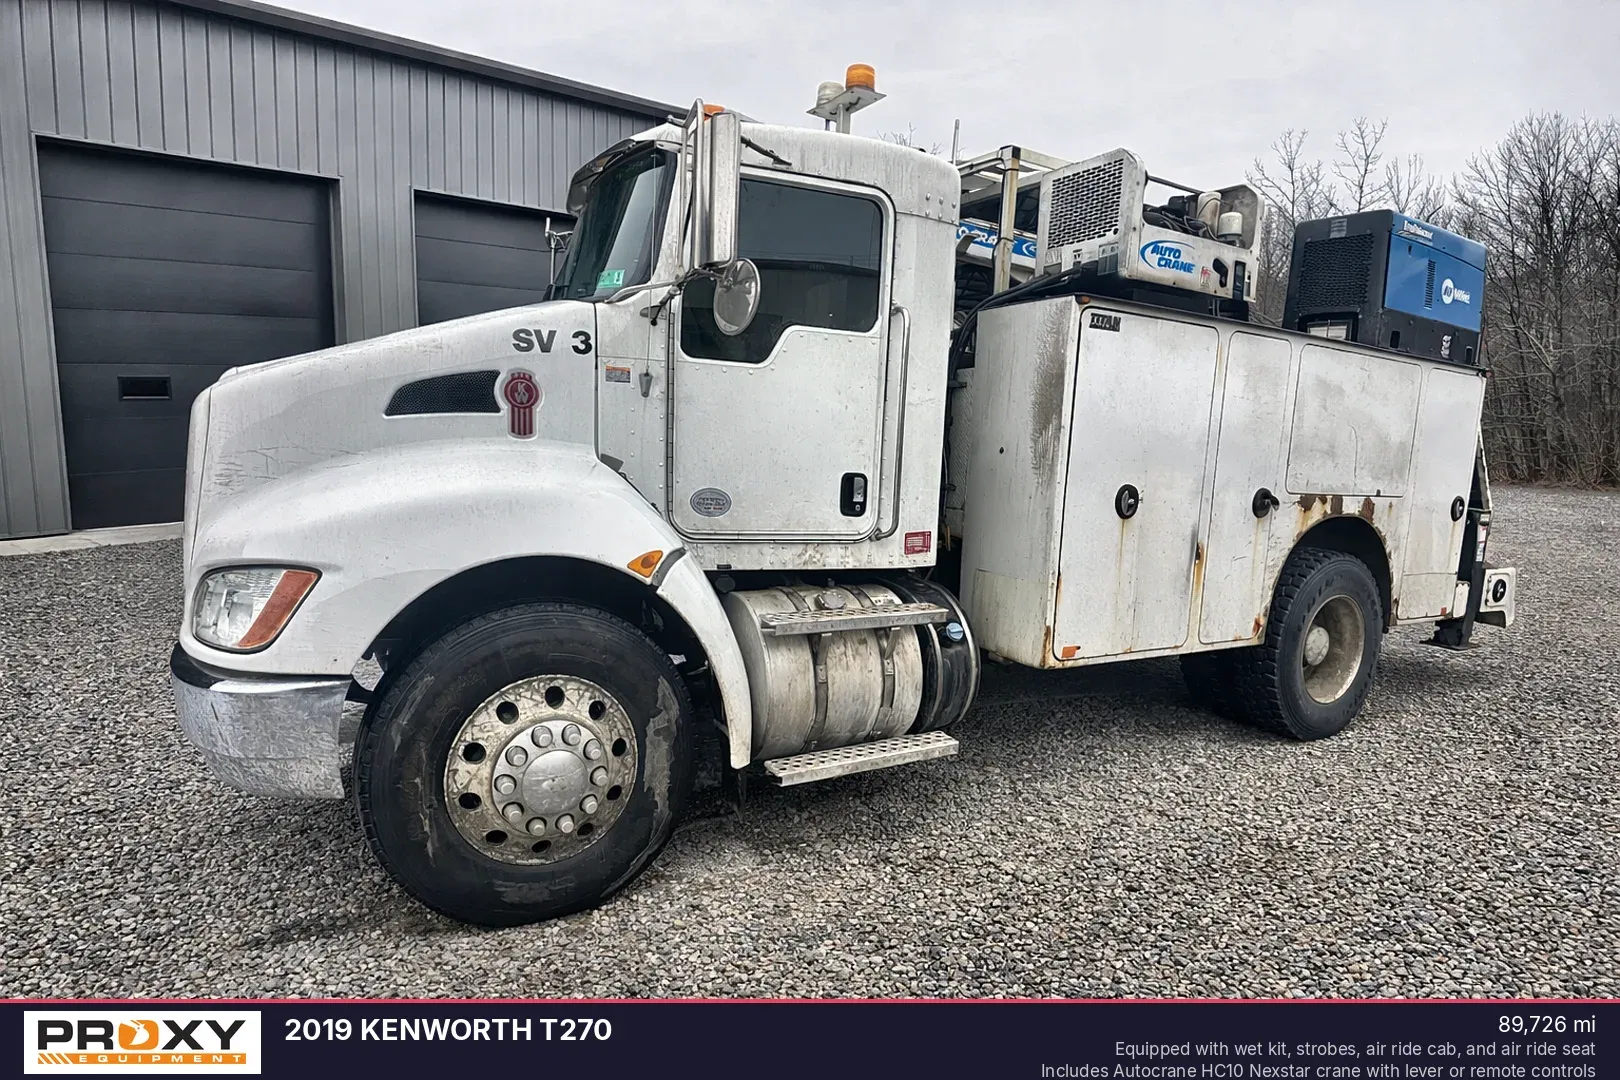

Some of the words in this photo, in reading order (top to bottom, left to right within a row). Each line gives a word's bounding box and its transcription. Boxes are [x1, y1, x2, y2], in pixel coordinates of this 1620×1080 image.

[1151, 243, 1182, 259] AUTO
[1157, 257, 1196, 274] CRANE
[512, 328, 557, 353] SV
[571, 331, 593, 355] 3
